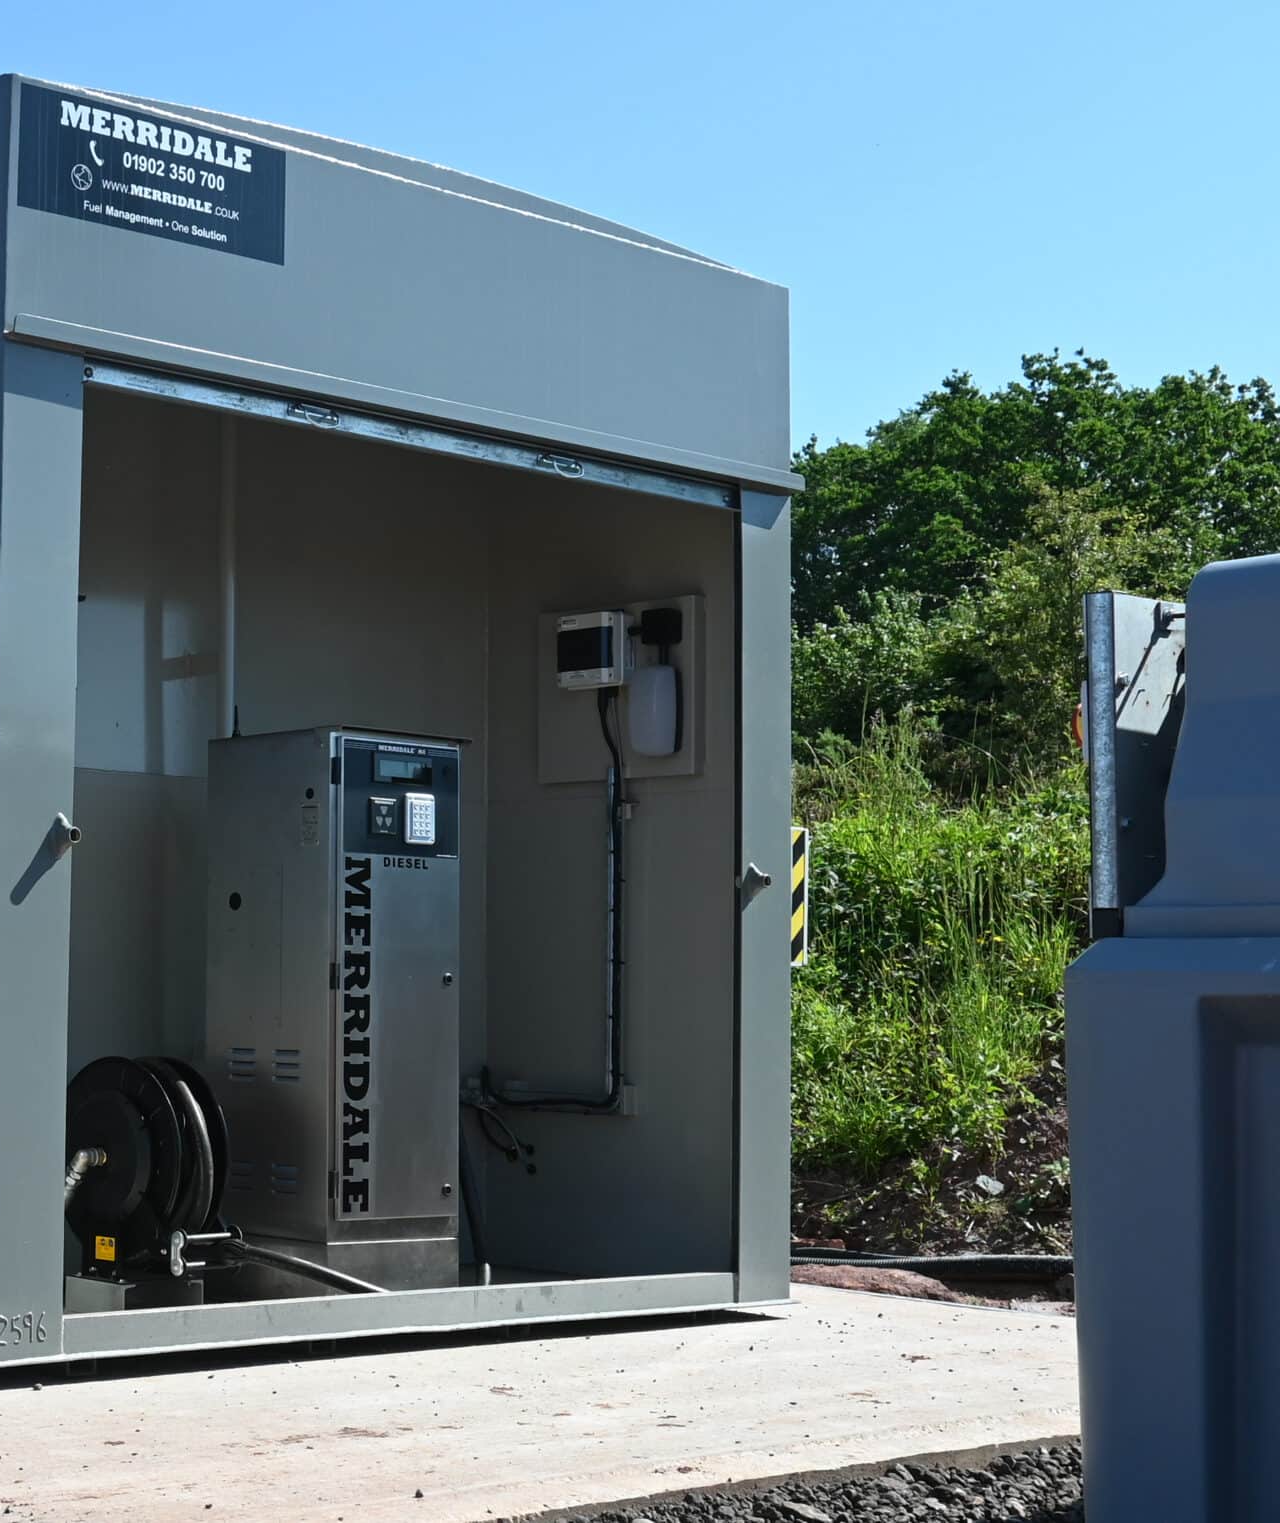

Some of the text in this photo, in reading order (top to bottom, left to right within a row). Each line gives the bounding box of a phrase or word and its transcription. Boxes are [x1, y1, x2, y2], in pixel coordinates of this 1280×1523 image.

[60, 100, 252, 173] MERRIDALE
[123, 151, 225, 192] 01902 350 700
[83, 200, 227, 243] Fuel Management One Solution
[383, 856, 429, 870] DIESEL
[342, 856, 371, 1214] MERRIDALE
